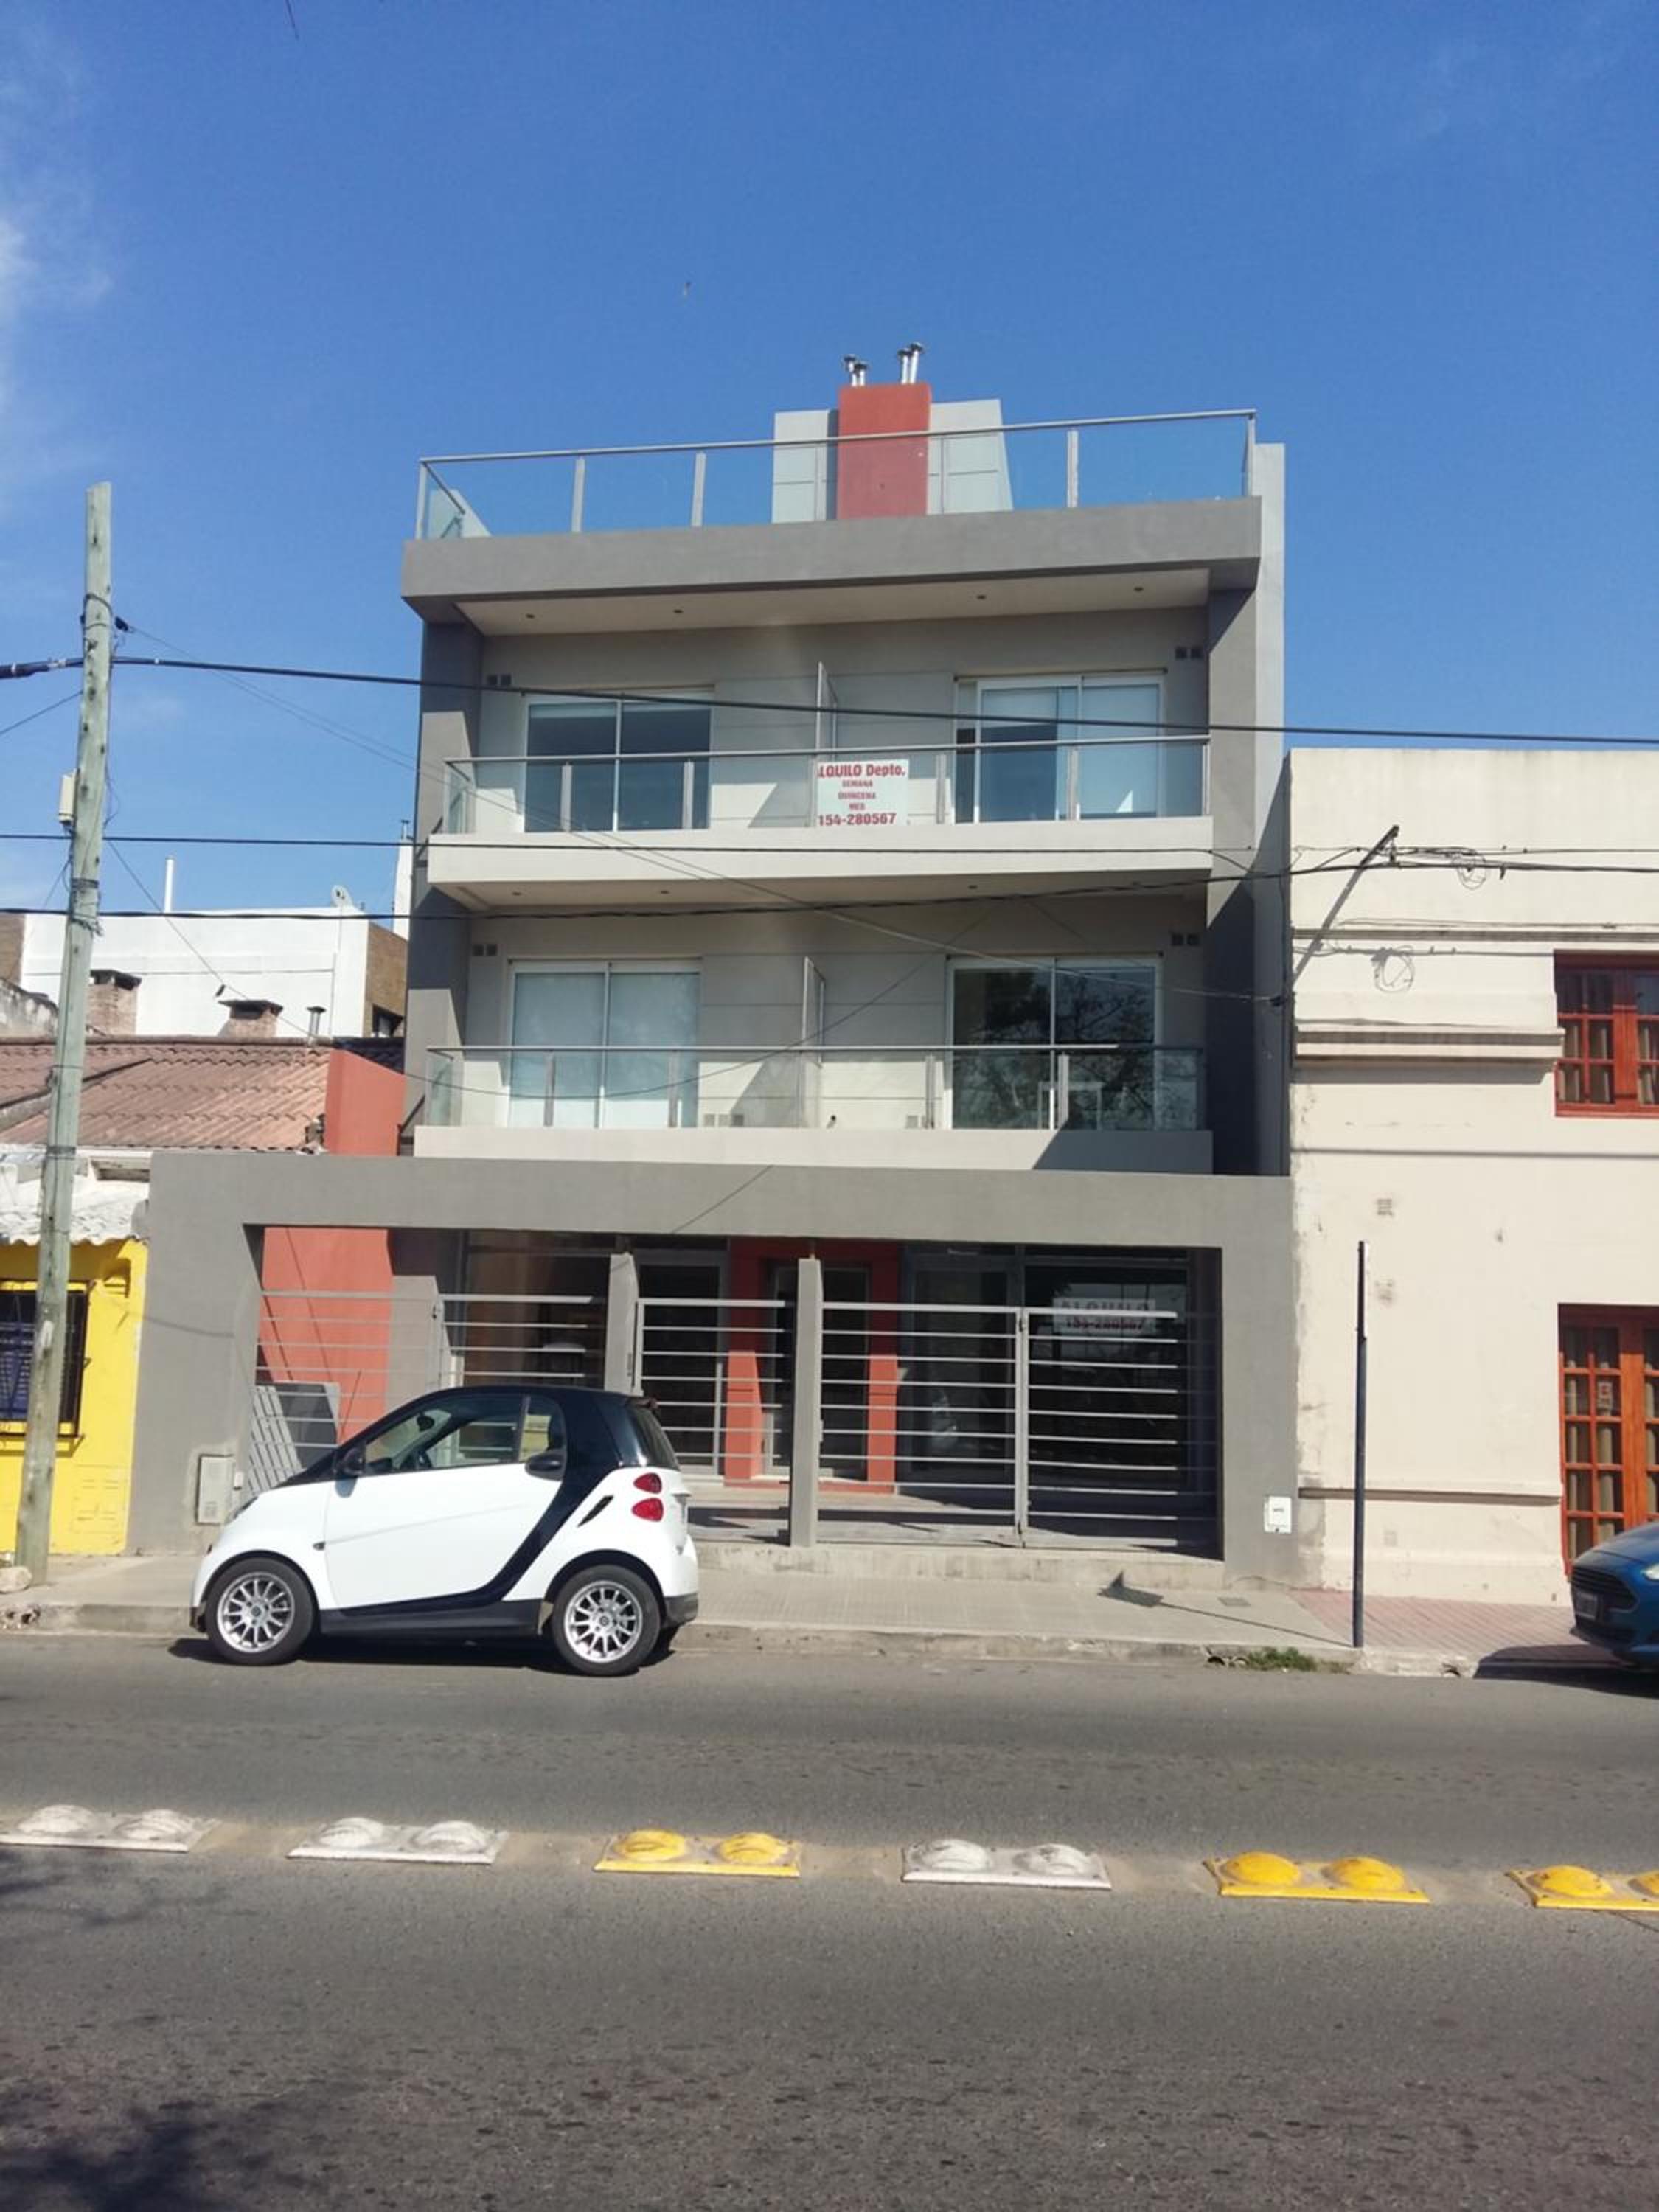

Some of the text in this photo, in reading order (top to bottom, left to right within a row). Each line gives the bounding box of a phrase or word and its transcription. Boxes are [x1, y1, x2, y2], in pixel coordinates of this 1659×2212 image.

[817, 763, 906, 779] LQUILO Depto.
[842, 779, 873, 787] SEMANA
[838, 791, 876, 800] QUINCENA
[849, 802, 866, 810] MES
[818, 813, 897, 827] 154-280567
